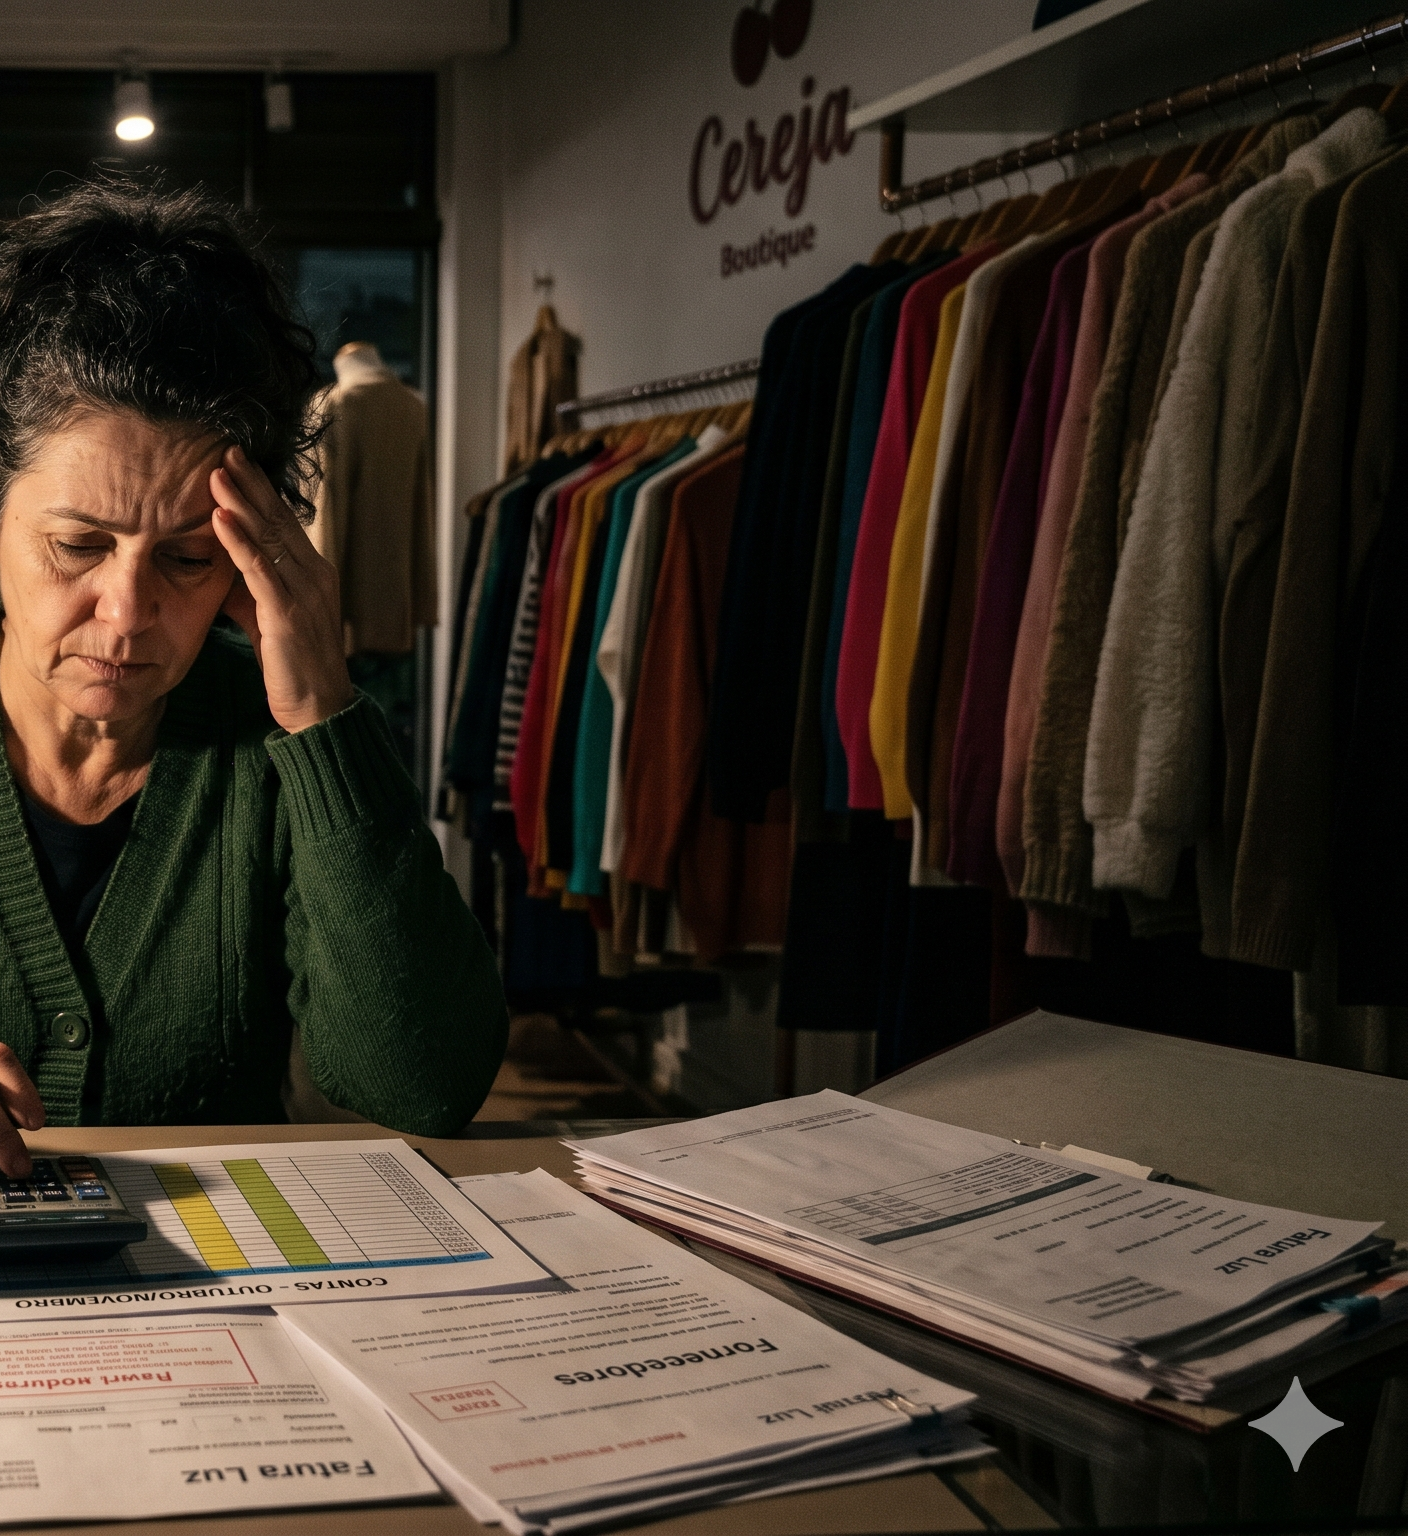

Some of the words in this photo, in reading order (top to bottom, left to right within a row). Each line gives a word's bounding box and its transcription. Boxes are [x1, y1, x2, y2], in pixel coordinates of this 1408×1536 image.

[690, 74, 855, 226] Cereja
[720, 223, 817, 279] Boutique
[1253, 1228, 1332, 1258] Fatura
[1214, 1256, 1268, 1275] Luz
[15, 1284, 272, 1309] OUTUBRO/NOVEMBRO
[294, 1277, 388, 1291] CONTAS
[553, 1338, 778, 1387] Fornecedores
[181, 1466, 247, 1485] Luz
[258, 1459, 375, 1480] Fatura
